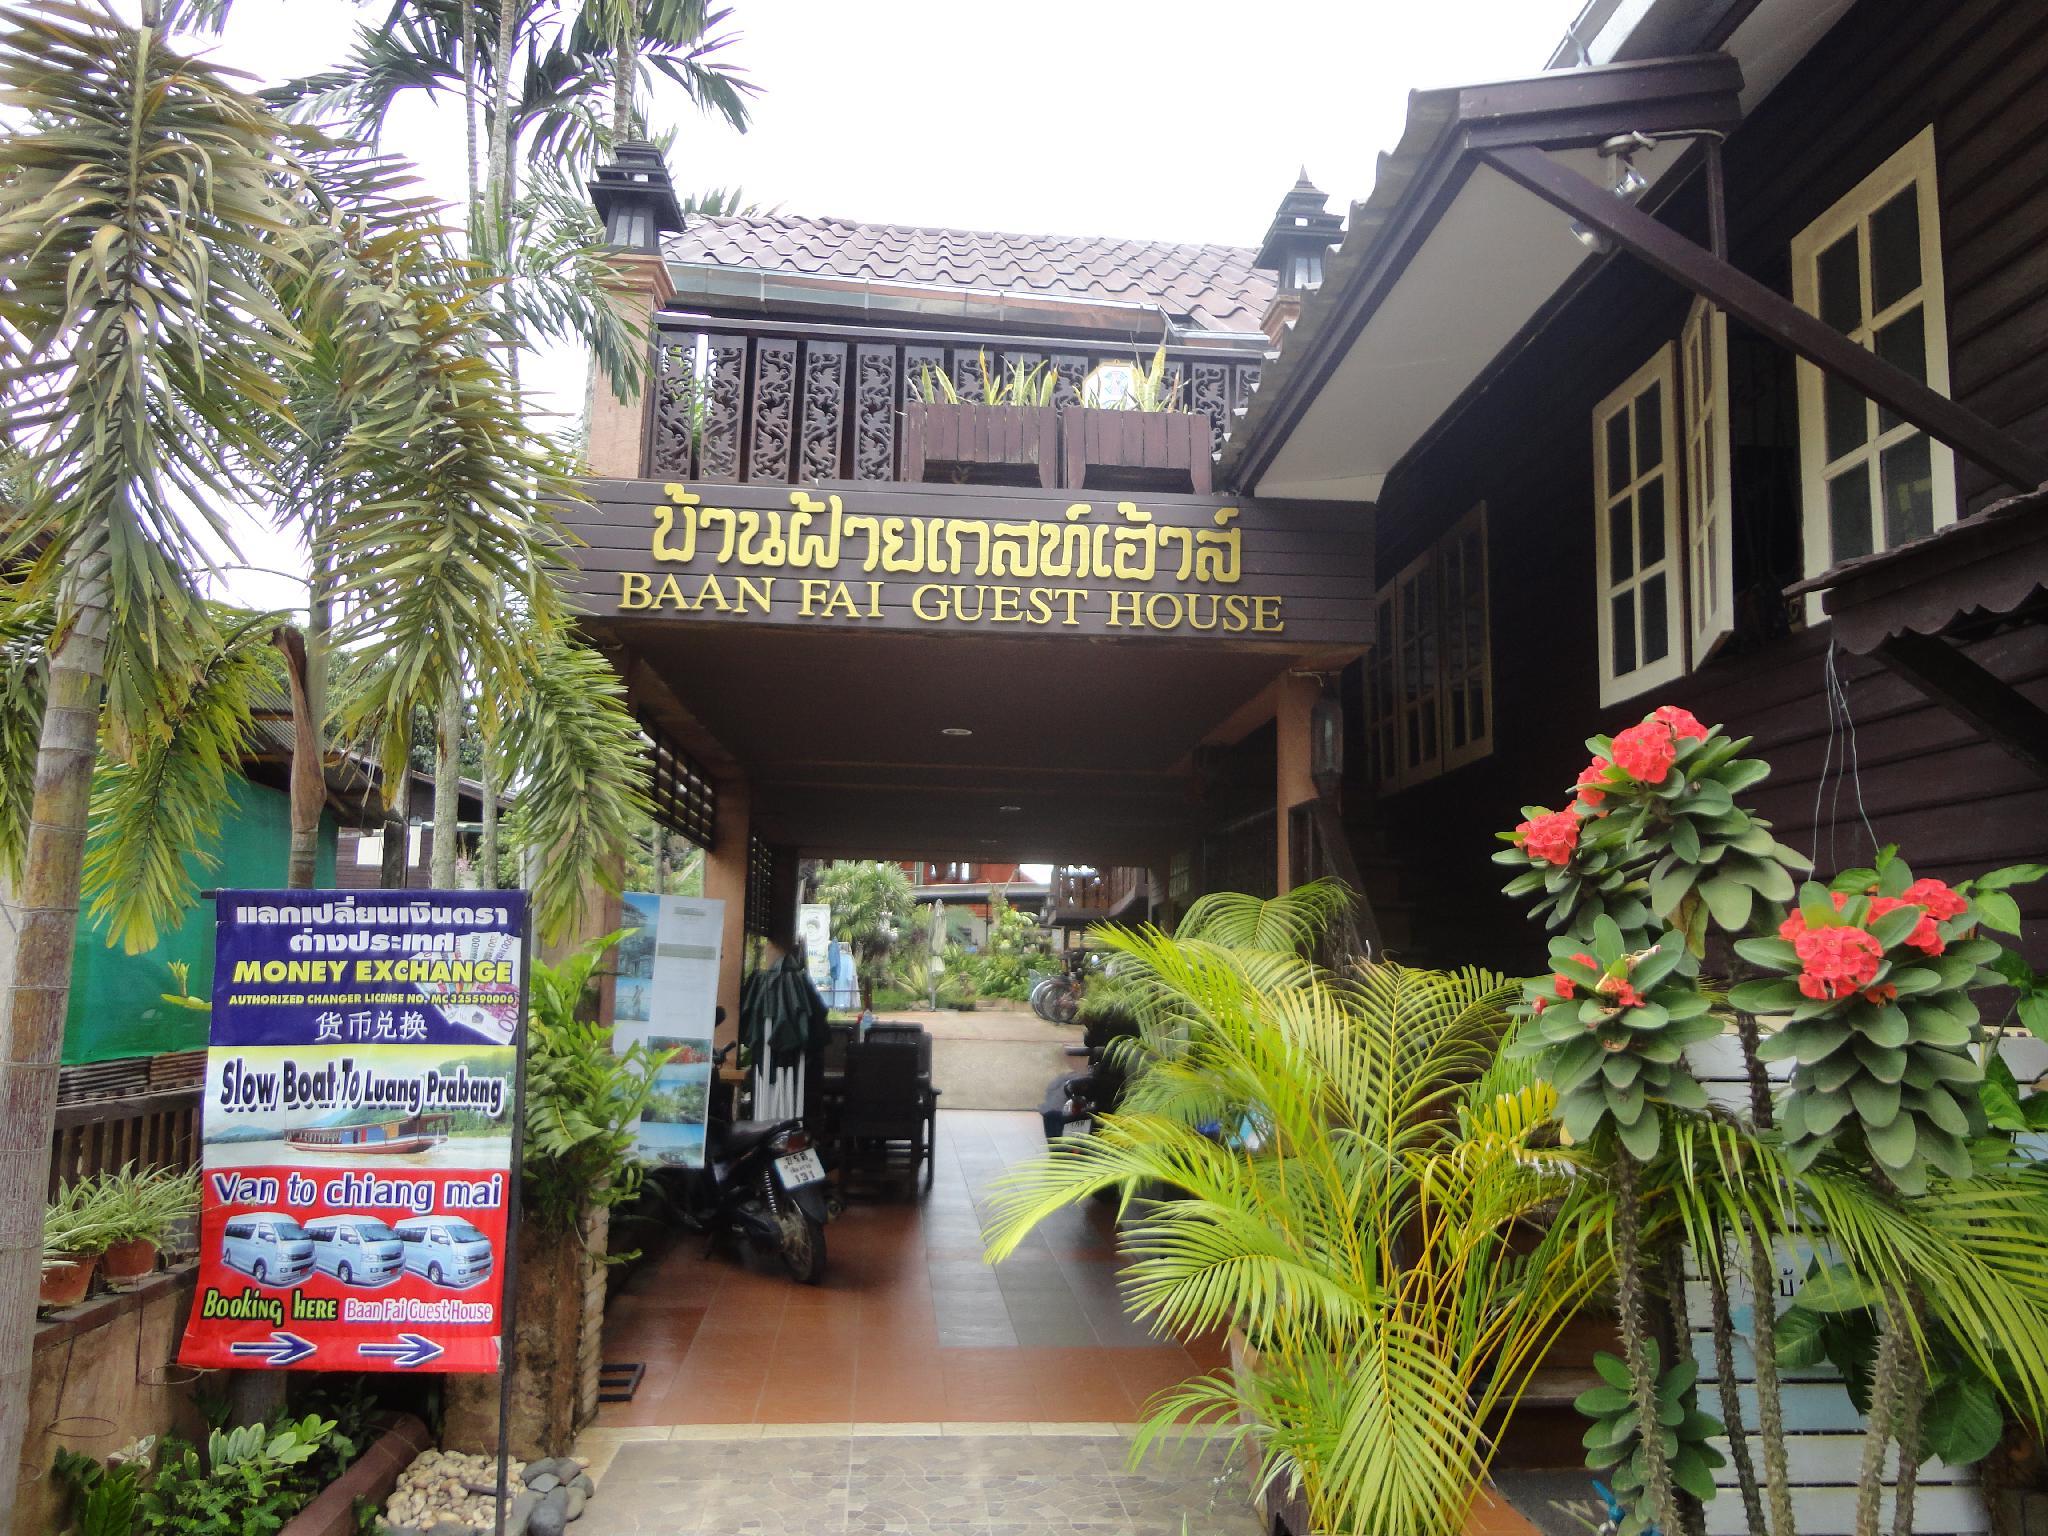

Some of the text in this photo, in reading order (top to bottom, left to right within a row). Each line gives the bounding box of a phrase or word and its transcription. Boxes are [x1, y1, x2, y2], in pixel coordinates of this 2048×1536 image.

[617, 572, 1284, 632] BAAN FAI GUEST HOUSE
[236, 896, 508, 924] แลกเปลี่ยนเงินตรา
[290, 927, 455, 952] ต่างประเทศ
[233, 960, 513, 983] MONEY EXCHANGE
[229, 994, 304, 1005] AUTHORIZED
[307, 993, 362, 1005] CHANGER
[365, 993, 404, 1004] LICENSE
[407, 993, 428, 1004] NO.
[314, 1010, 428, 1041] 货币兑换
[221, 1057, 502, 1112] Slow Boat To Luang Prabang
[213, 1173, 502, 1212] Van to chiang mai
[346, 1299, 381, 1319] Baan
[384, 1299, 406, 1319] Fai
[409, 1300, 449, 1320] Guest
[451, 1300, 492, 1320] House
